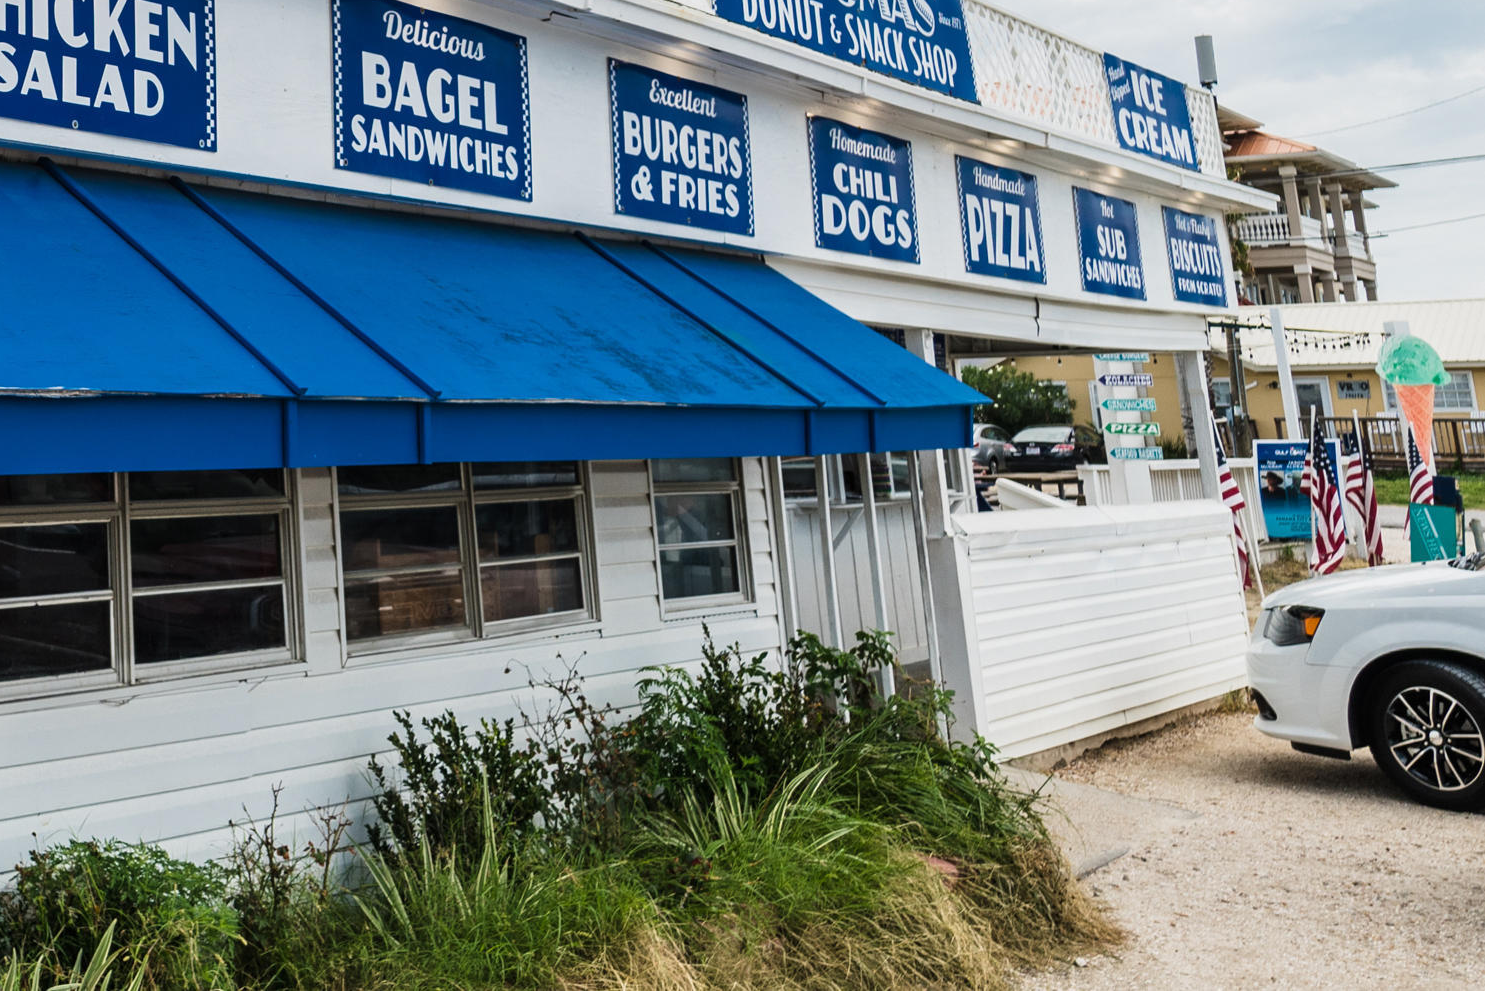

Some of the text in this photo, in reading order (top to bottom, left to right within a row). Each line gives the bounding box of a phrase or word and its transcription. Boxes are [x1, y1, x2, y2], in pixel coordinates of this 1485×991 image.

[383, 10, 486, 61] Delicious
[938, 11, 951, 26] Since
[829, 13, 842, 44] &
[845, 13, 909, 73] SNACK
[908, 36, 958, 88] SHOP
[1108, 61, 1125, 82] Hand
[361, 50, 508, 136] BAGEL
[649, 78, 717, 118] Excellent
[1130, 70, 1167, 116] ICE
[351, 114, 519, 181] SANDWICHES
[622, 110, 743, 179] BURGERS
[829, 128, 896, 164] Homemade
[1118, 107, 1194, 164] CREAM
[631, 165, 740, 218] & FRIES
[833, 162, 898, 204] CHILI
[973, 166, 1025, 196] Handmade
[821, 193, 912, 249] DOGS
[1100, 200, 1114, 219] Hot
[1174, 214, 1186, 232] Hot
[966, 193, 1041, 273] PIZZA
[1097, 224, 1127, 260] SUB
[1085, 257, 1141, 289] SANDWICHES
[1170, 237, 1221, 278] BISCUITS
[1178, 277, 1222, 297] FROM SCRATCH
[1105, 375, 1152, 386] KOLACHES
[1111, 424, 1157, 434] PIZZA
